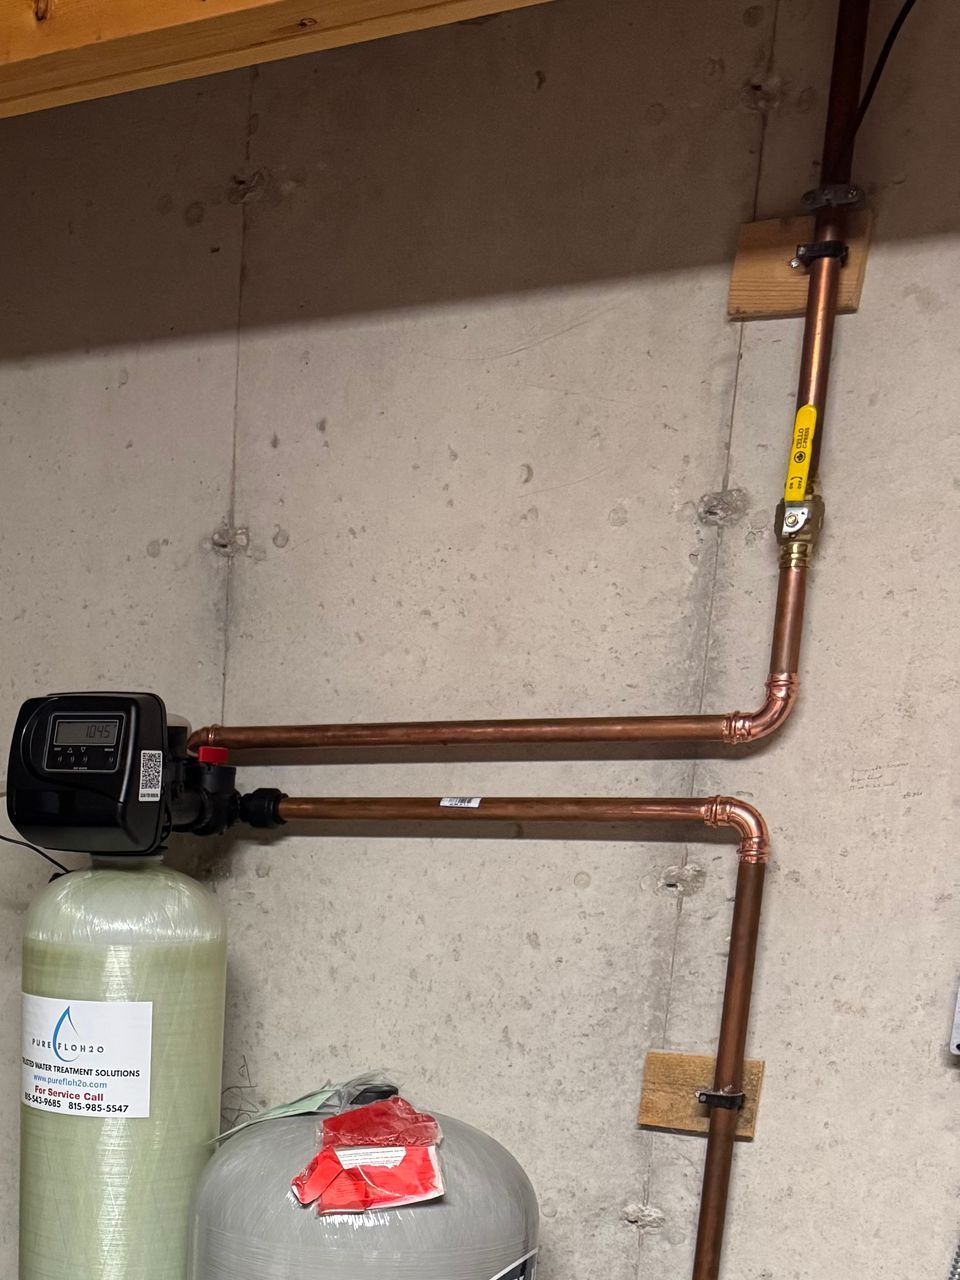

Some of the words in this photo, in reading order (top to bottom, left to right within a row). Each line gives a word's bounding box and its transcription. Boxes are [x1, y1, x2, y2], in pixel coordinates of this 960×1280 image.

[31, 1038, 52, 1049] PURE
[53, 1065, 93, 1077] TREATMENT
[95, 1068, 140, 1078] SOLUTIONS
[33, 1074, 108, 1089] www.purefloh2o.com
[34, 1085, 46, 1095] For
[47, 1088, 80, 1100] Service
[83, 1093, 104, 1102] Call
[68, 1102, 129, 1113] 815-985-5547
